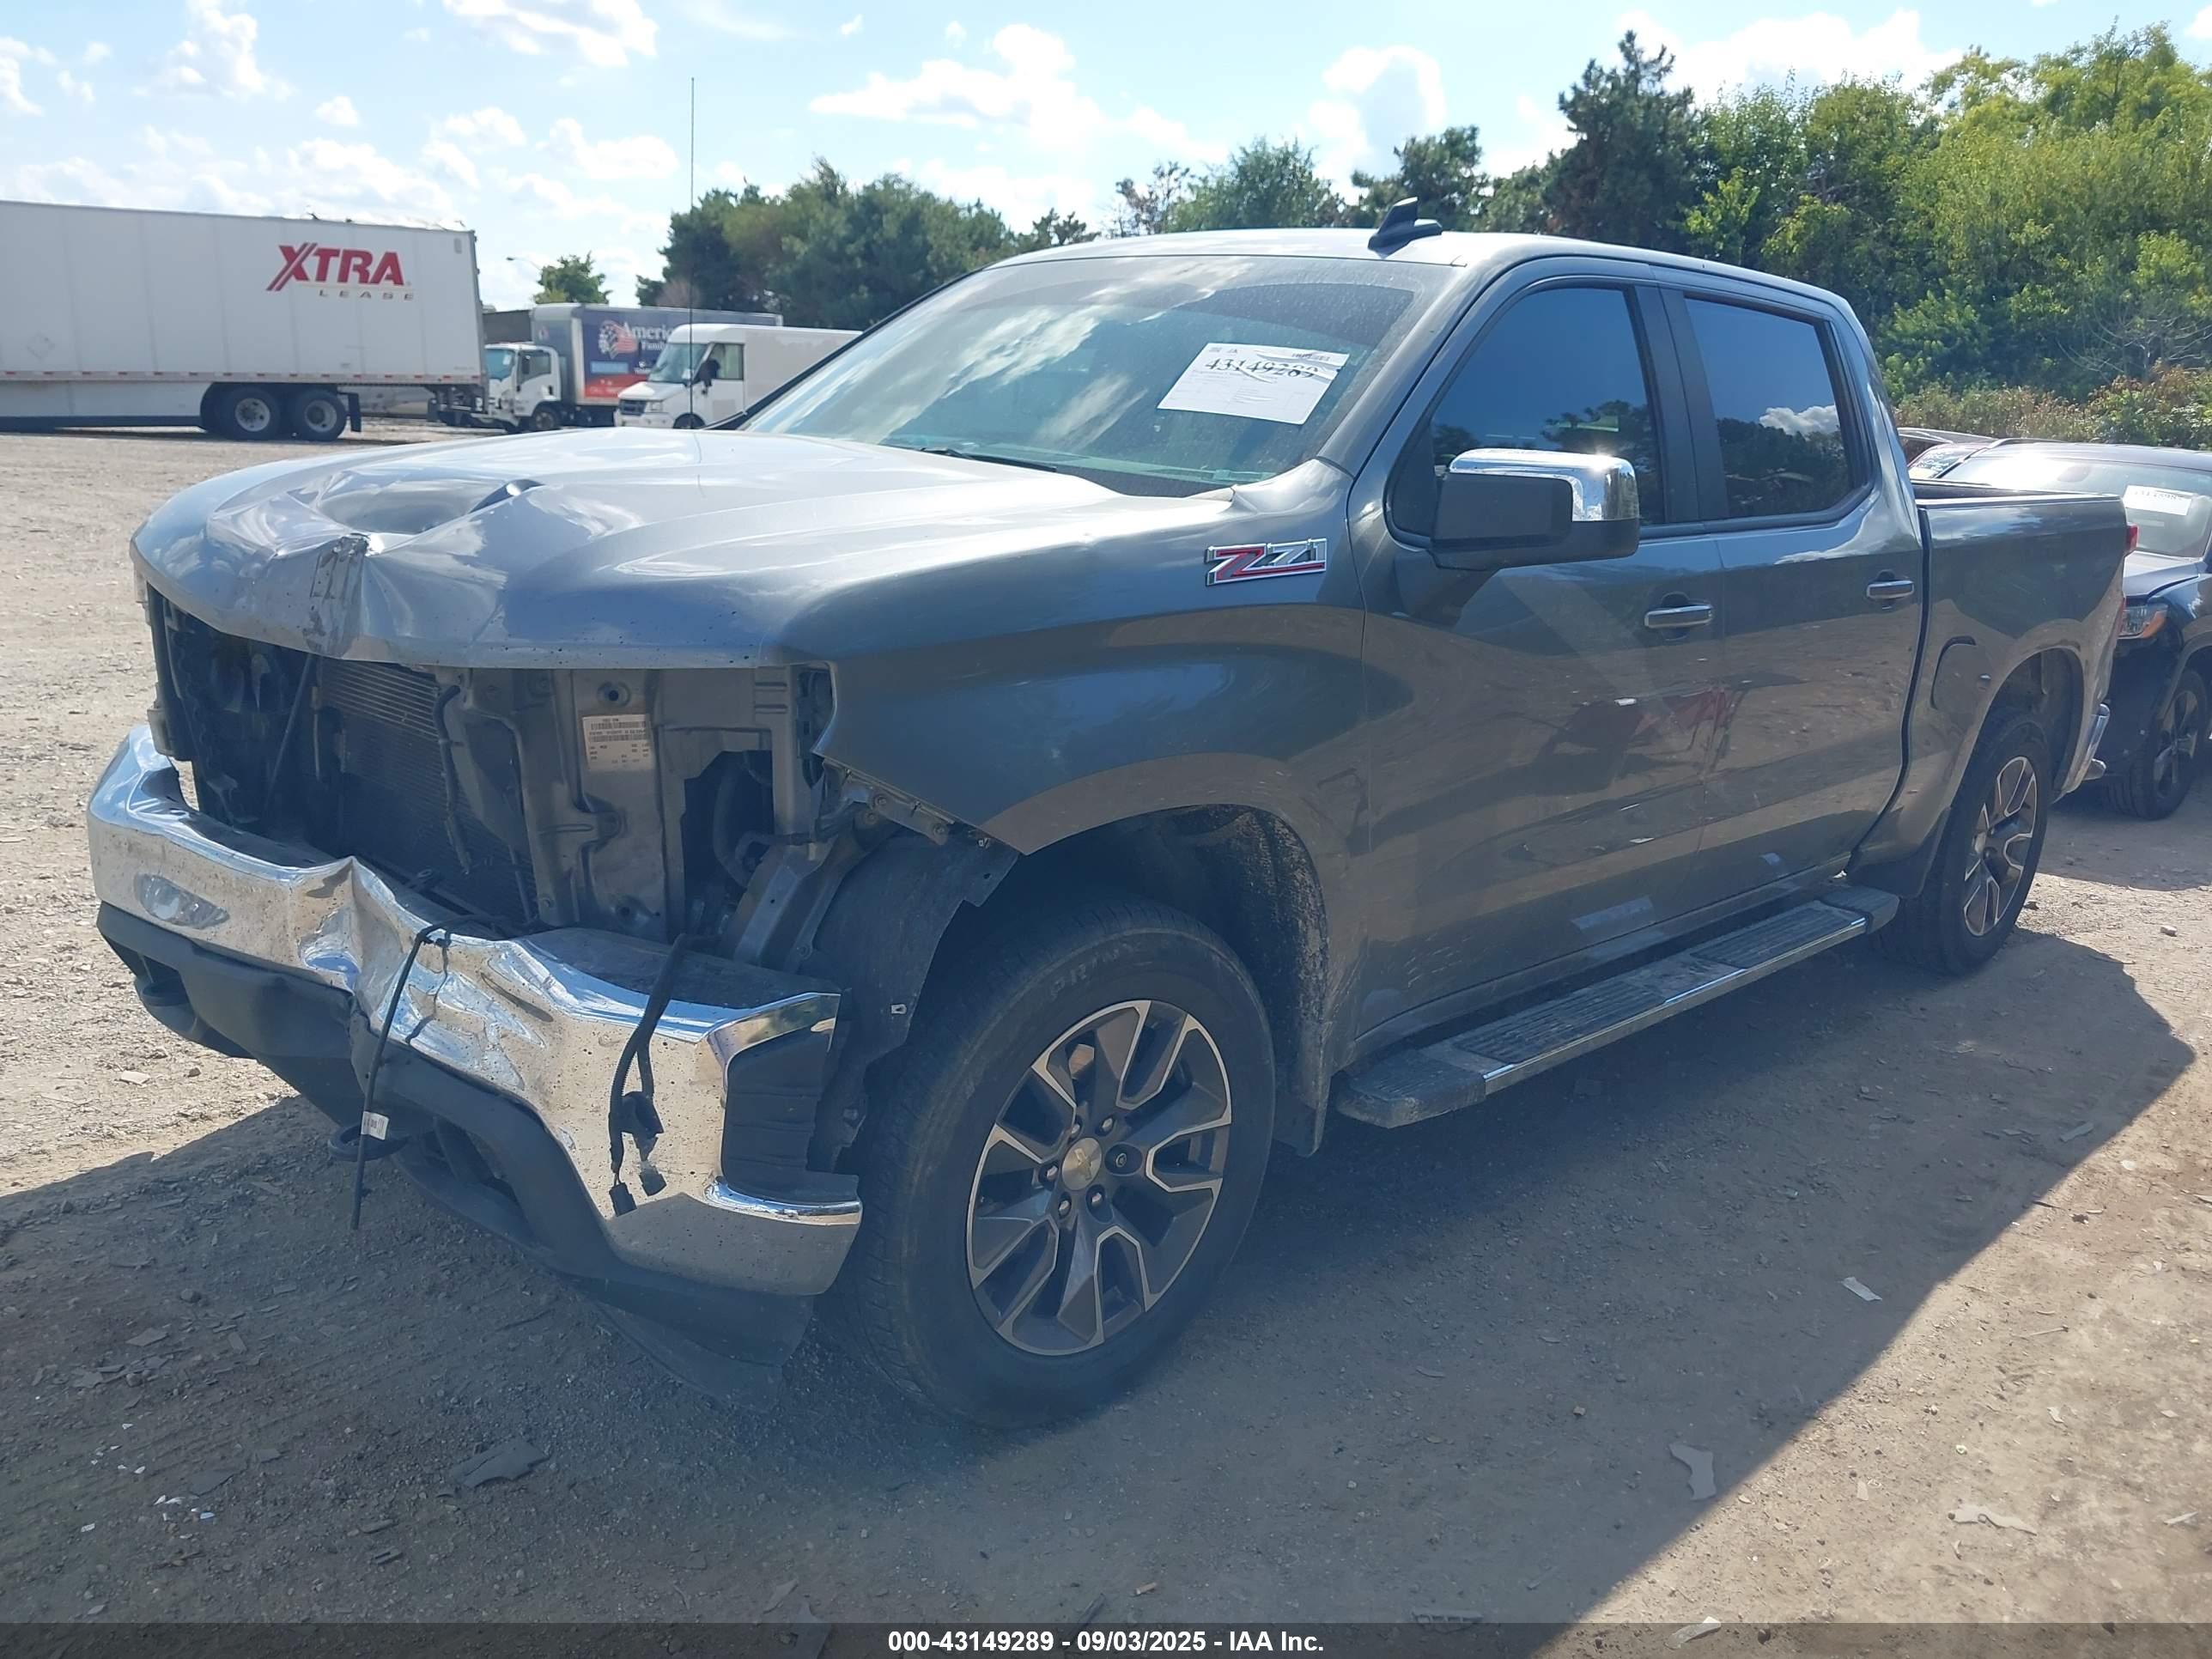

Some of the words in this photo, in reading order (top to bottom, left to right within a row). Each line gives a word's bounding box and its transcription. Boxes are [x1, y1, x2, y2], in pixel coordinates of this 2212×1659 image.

[266, 242, 404, 291] XTRA
[319, 289, 414, 301] LEASE
[1205, 538, 1328, 586] Z71
